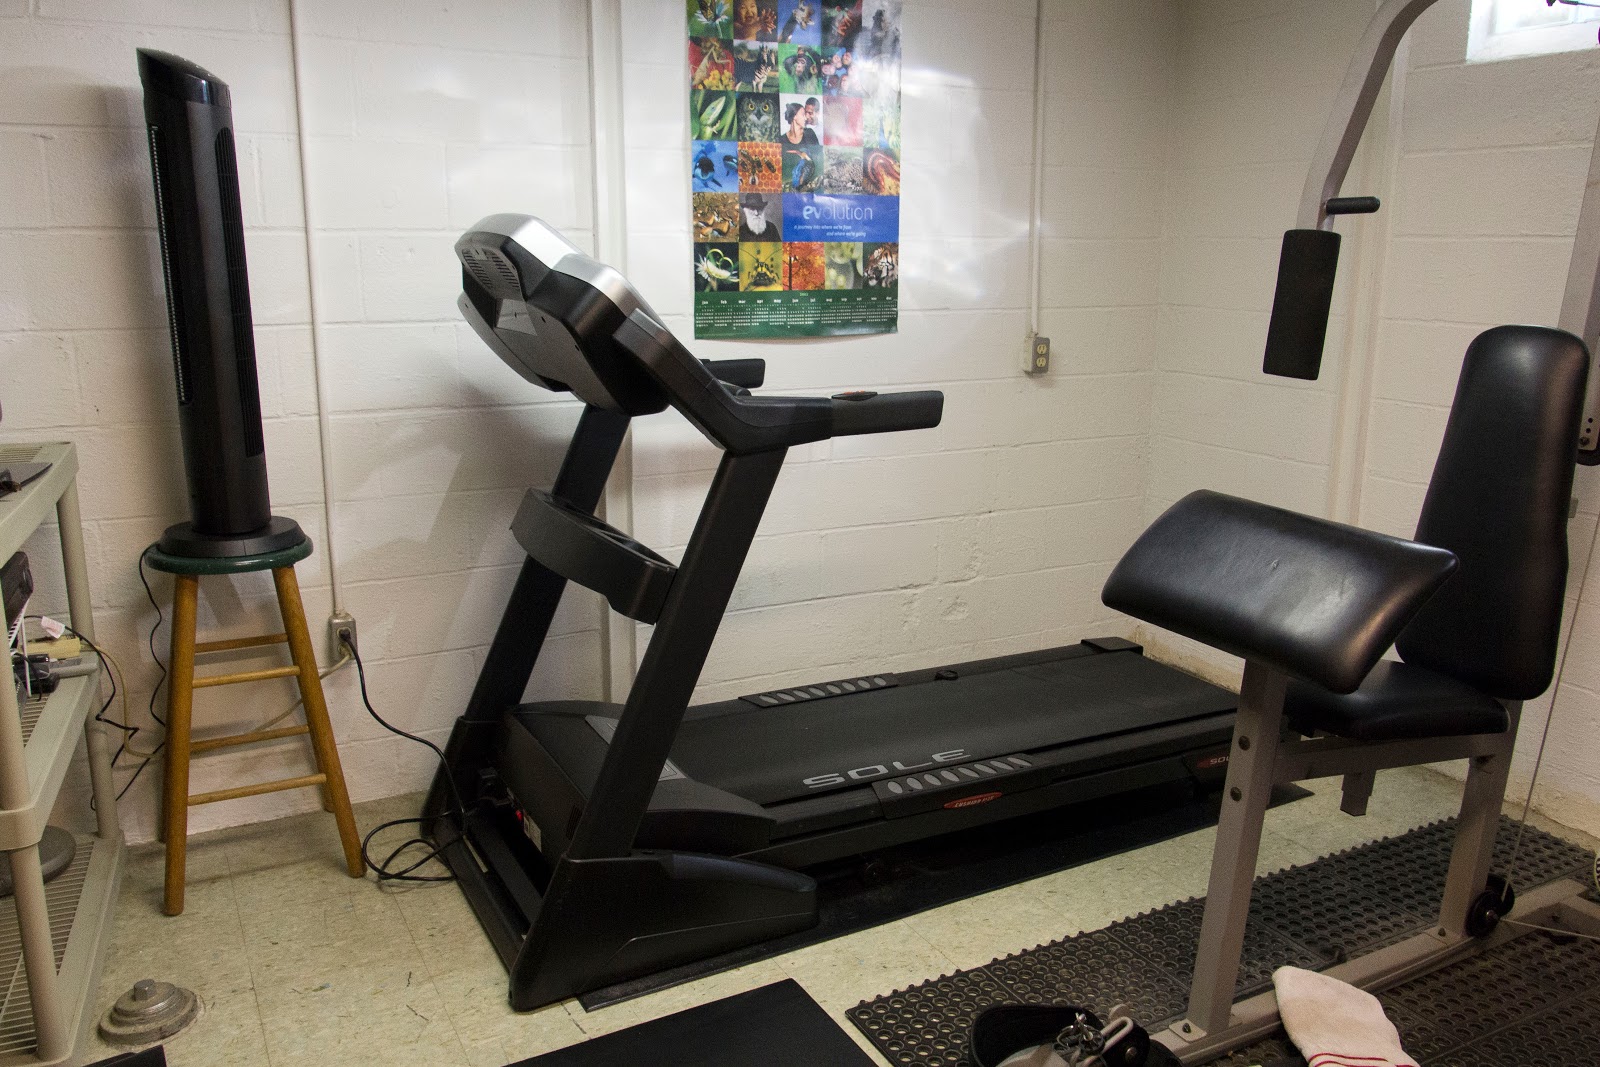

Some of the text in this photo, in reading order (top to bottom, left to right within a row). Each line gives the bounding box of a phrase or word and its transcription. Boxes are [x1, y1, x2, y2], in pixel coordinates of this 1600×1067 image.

[802, 202, 873, 220] evolution
[802, 748, 972, 789] SOLE
[1210, 756, 1229, 765] SOL
